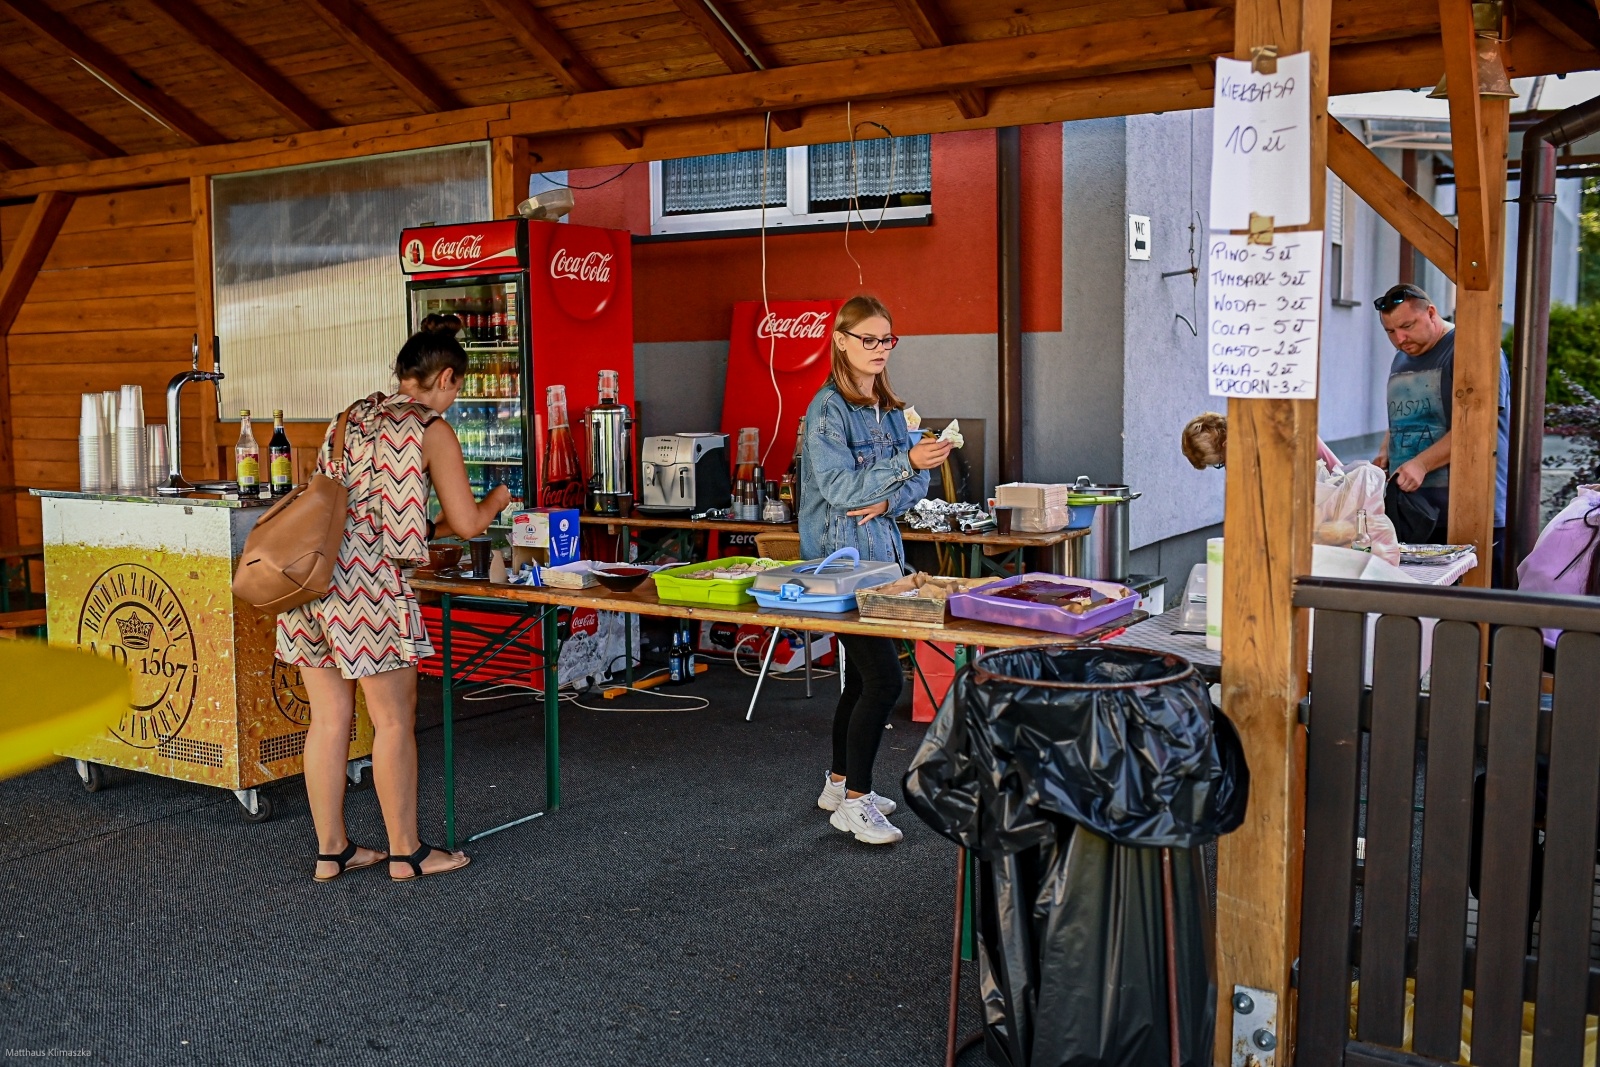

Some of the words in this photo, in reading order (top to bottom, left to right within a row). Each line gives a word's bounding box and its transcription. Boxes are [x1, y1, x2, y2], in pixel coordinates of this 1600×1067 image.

[1225, 125, 1258, 154] 10
[1134, 221, 1146, 236] WC
[431, 234, 485, 261] Coca-Cola
[550, 248, 613, 283] Coca-Cola
[756, 311, 832, 339] Coca-Cola
[83, 572, 127, 634] BROWAR
[130, 571, 189, 642] ZAMKOWY
[139, 643, 189, 693] 1567
[118, 700, 181, 741] CIBÓRZ
